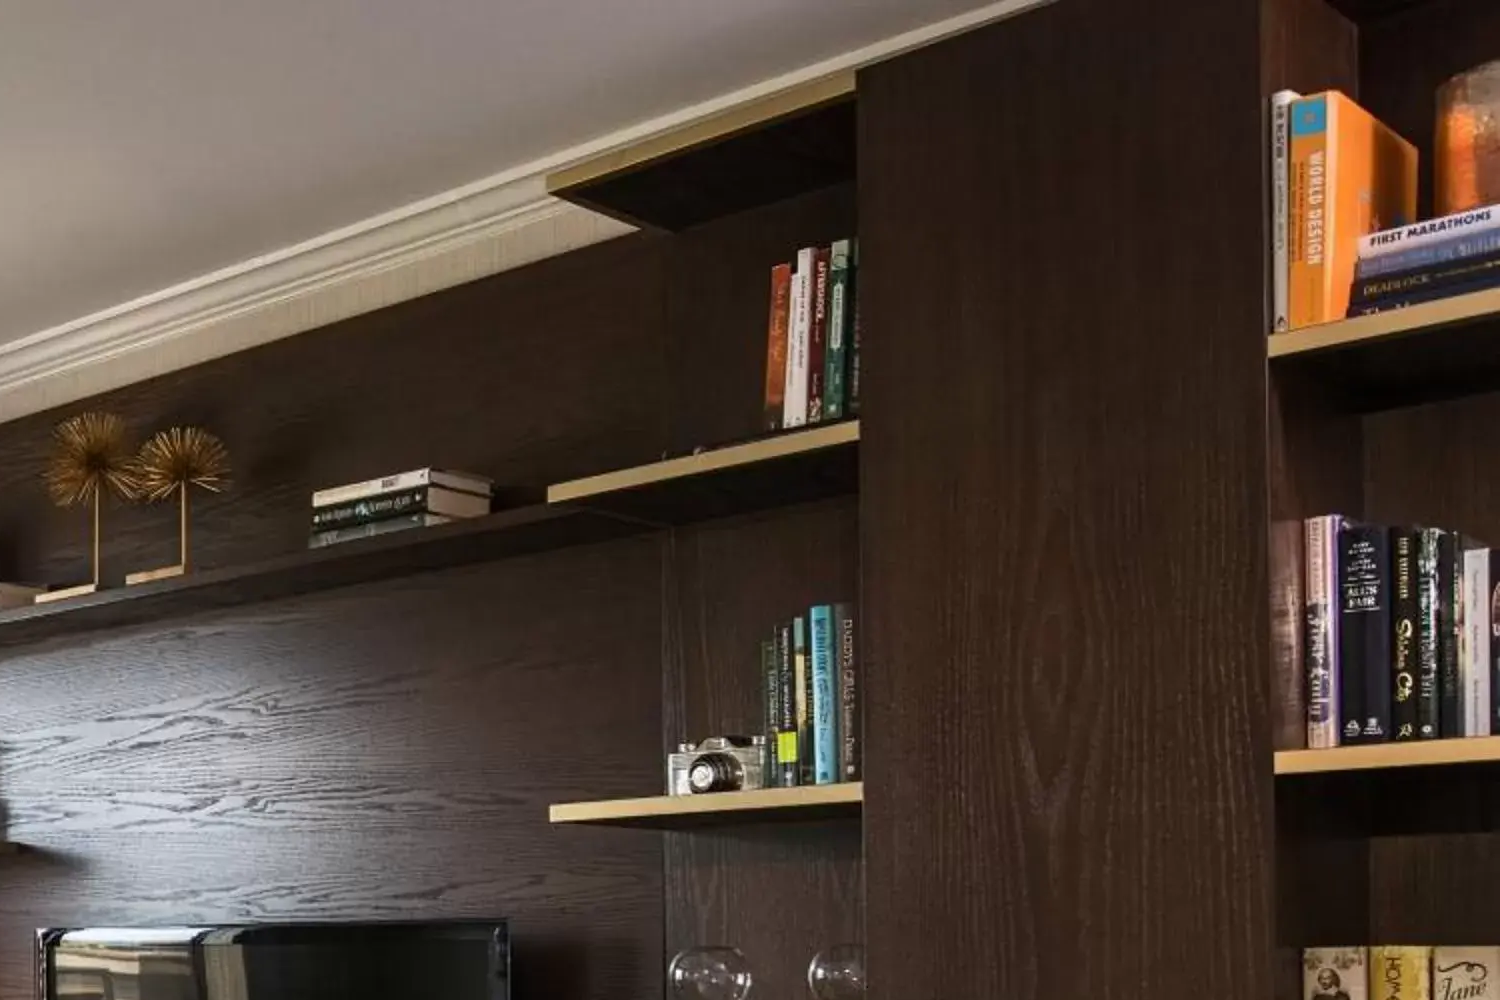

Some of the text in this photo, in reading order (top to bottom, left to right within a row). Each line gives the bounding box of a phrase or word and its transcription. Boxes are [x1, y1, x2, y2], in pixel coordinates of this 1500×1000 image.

[1307, 150, 1325, 265] WORLD DESIGN
[1370, 210, 1492, 247] FIRST MARATHONS
